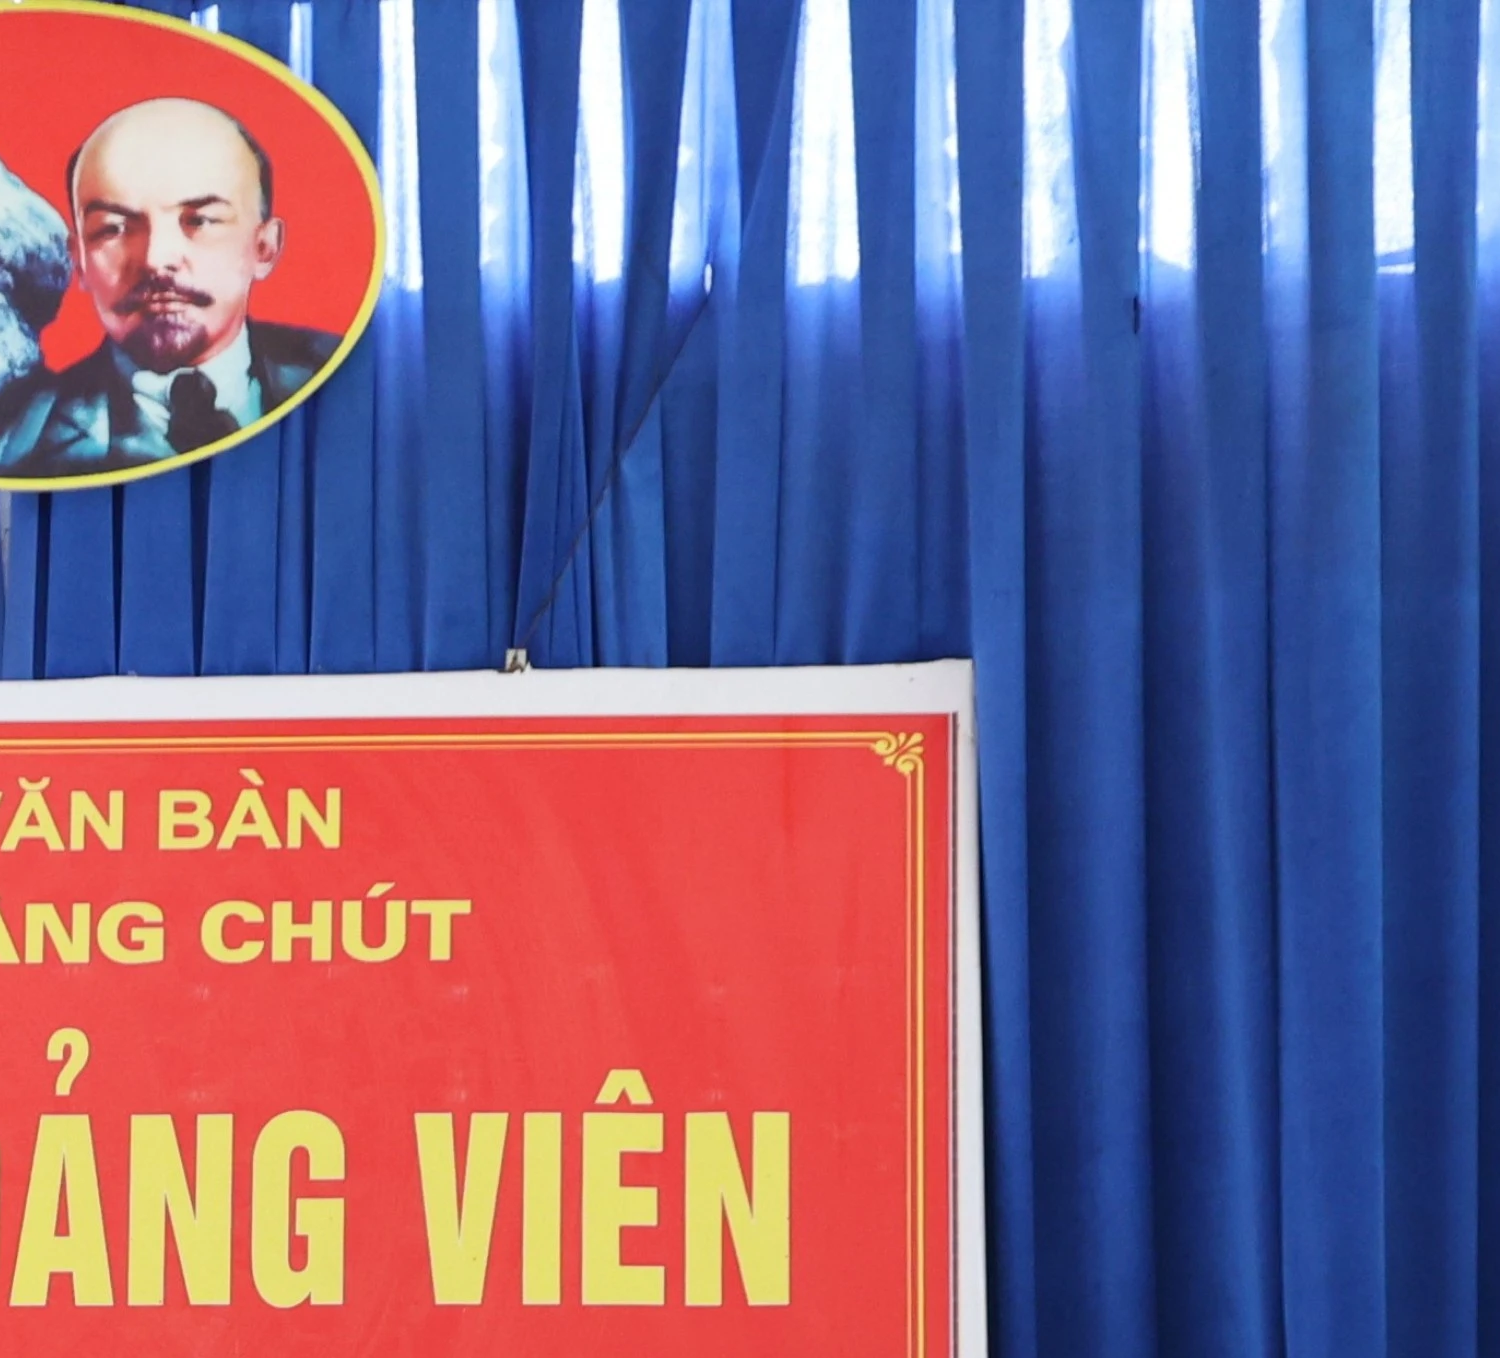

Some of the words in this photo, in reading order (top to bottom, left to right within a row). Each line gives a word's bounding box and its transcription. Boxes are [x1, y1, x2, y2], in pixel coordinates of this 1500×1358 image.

[157, 769, 342, 851] BÀN
[200, 884, 473, 965] CHÚT
[413, 1068, 791, 1307] VIÊN
